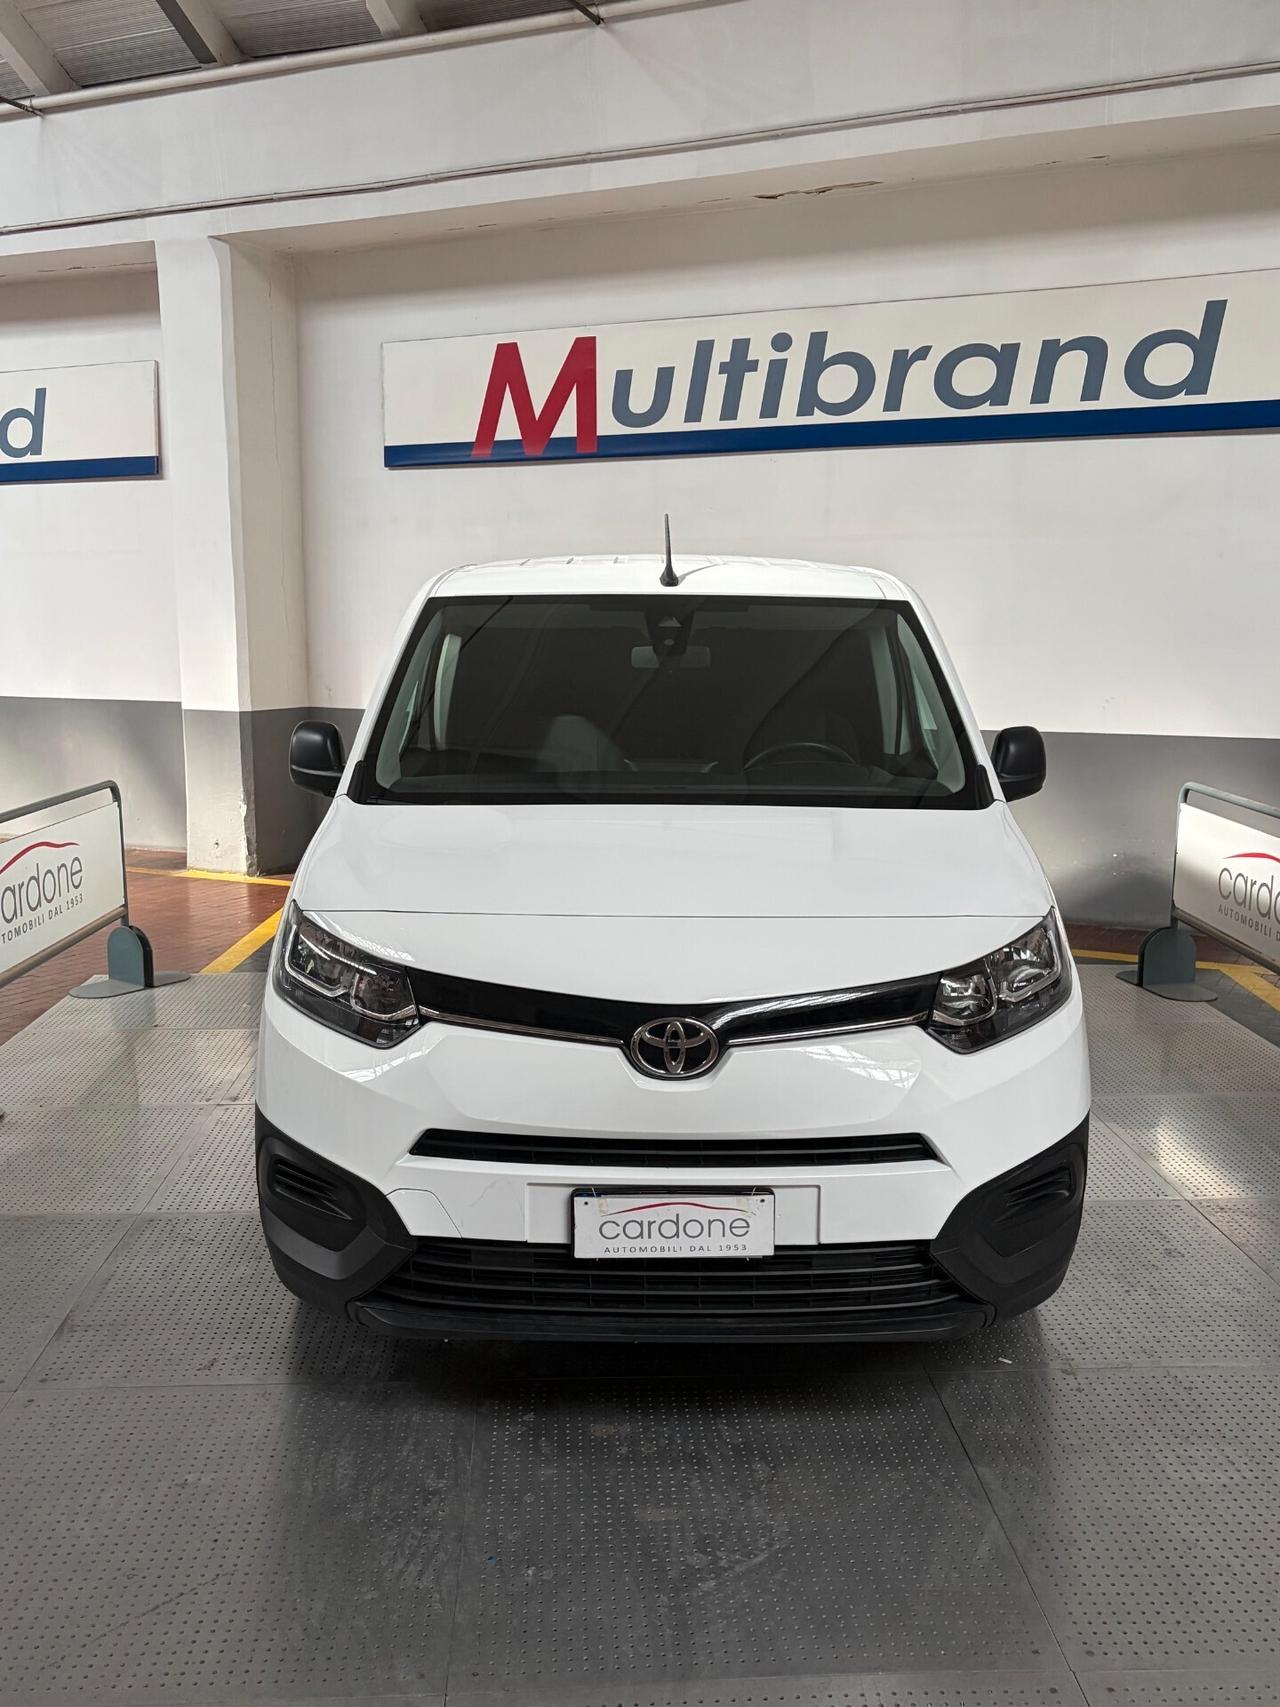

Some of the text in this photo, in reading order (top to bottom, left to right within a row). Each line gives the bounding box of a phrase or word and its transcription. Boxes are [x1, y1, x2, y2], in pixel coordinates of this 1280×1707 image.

[471, 299, 1228, 458] Multibrand
[1, 856, 83, 924] ardone
[48, 905, 63, 920] DAL
[66, 892, 83, 910] 1953
[1218, 903, 1272, 937] AUTOMOBILI
[599, 1213, 750, 1240] cardone
[604, 1243, 748, 1254] AUTOMOBILI DAL 1953
